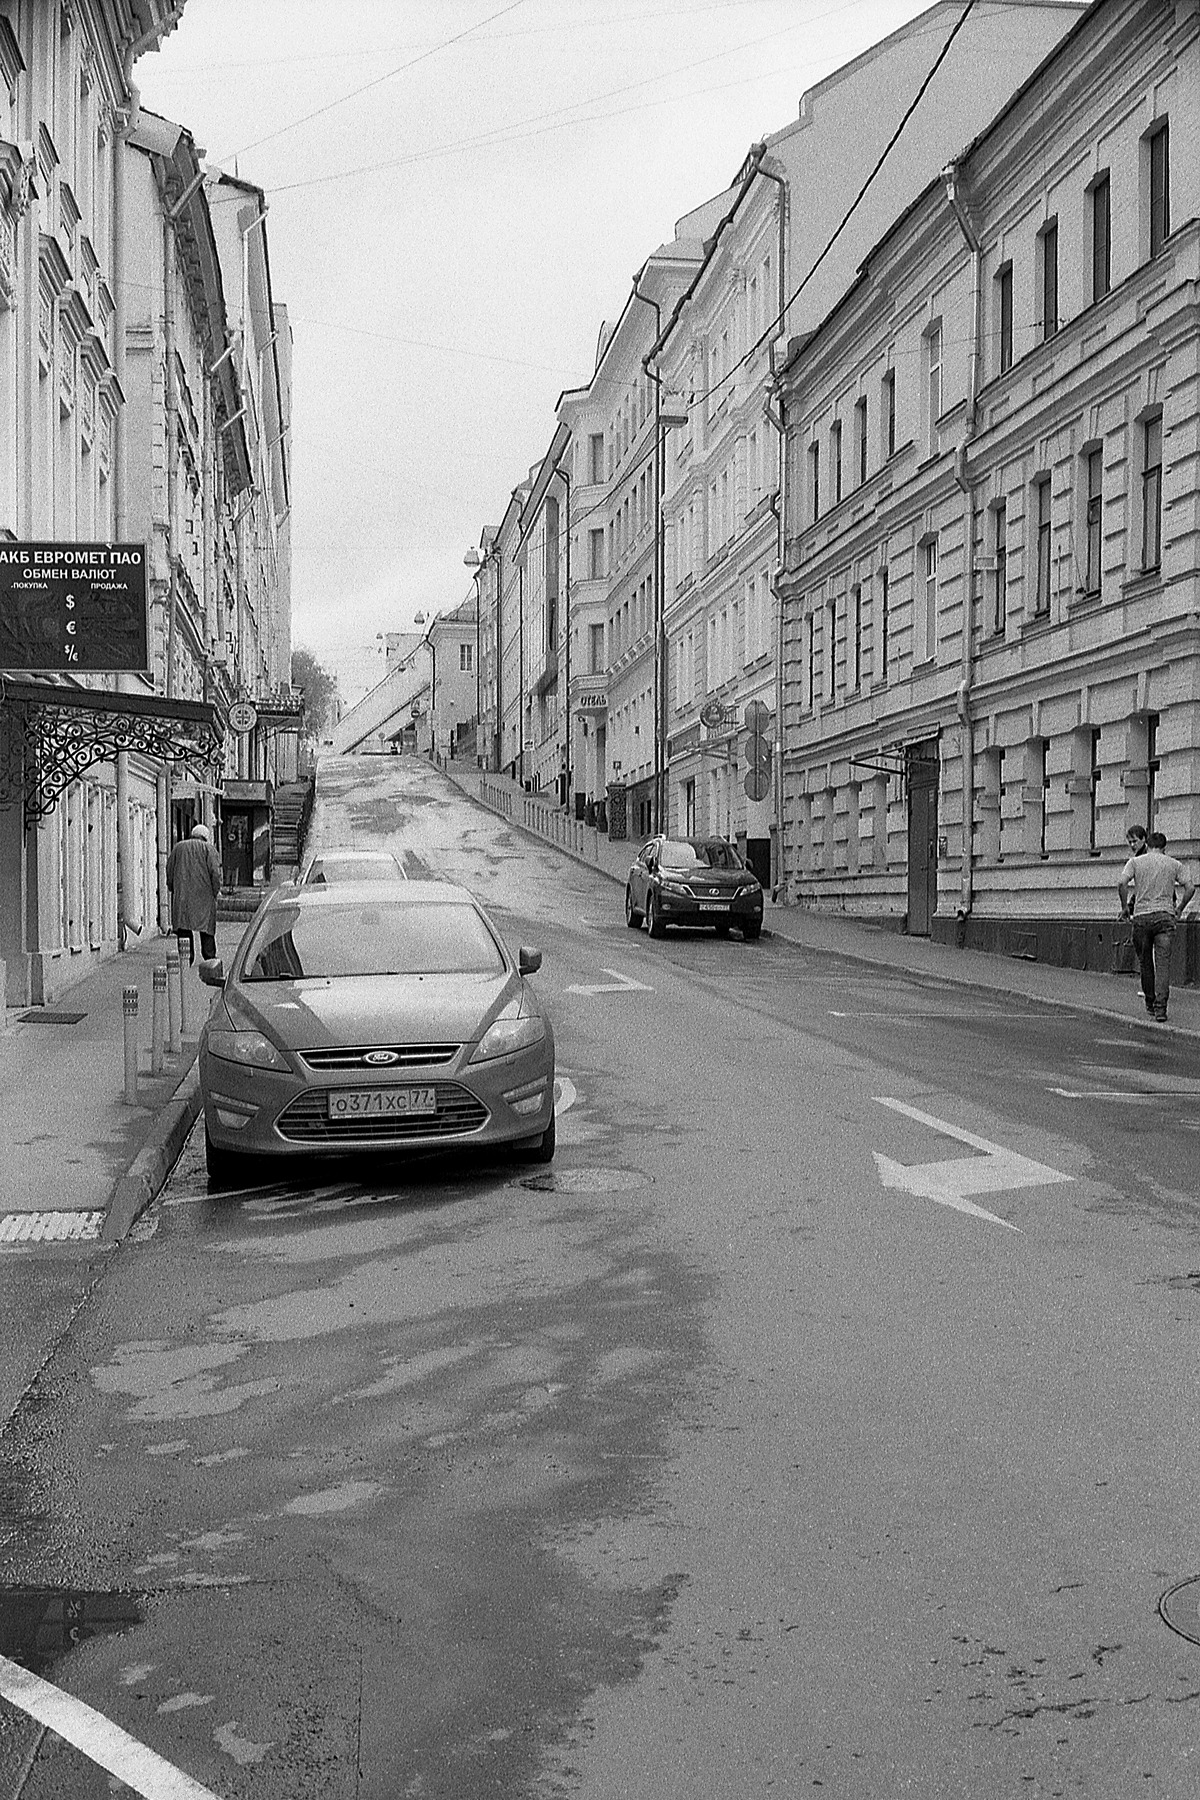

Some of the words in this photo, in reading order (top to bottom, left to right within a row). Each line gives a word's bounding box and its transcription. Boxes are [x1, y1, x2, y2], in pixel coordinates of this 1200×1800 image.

[0, 551, 30, 563] АКБ
[34, 551, 107, 564] ЕВРОМЕТ
[110, 552, 141, 565] ПАО
[23, 568, 68, 579] ОБМЕН
[71, 569, 117, 580] ВАЛЮТ
[65, 594, 75, 610] $
[66, 621, 76, 634] €
[580, 694, 607, 706] ОТЕЛЬ
